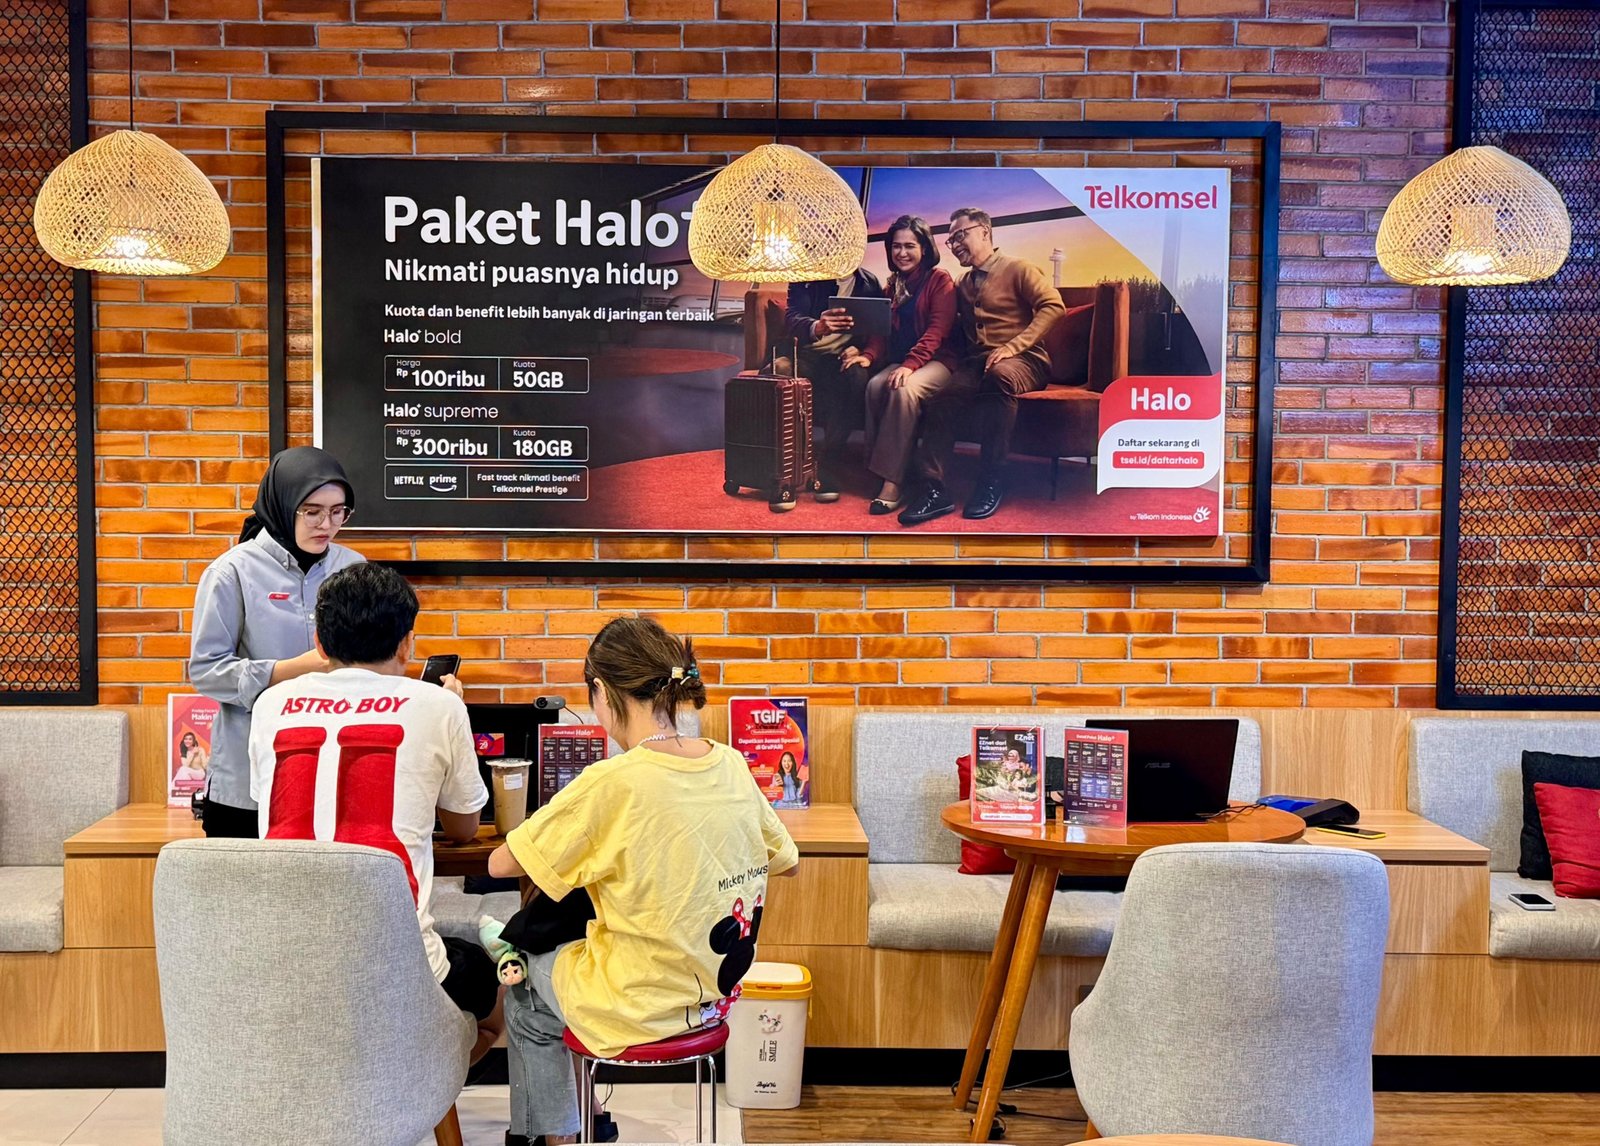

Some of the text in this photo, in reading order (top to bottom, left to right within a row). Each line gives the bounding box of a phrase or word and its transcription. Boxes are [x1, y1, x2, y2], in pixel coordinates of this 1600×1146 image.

[1084, 184, 1218, 210] Telkomsel
[384, 195, 541, 246] Paket
[384, 258, 679, 290] Nikmati puasnya hidup
[384, 304, 715, 323] Kuota dan benefit lebih banyak di jaringan terbaik
[424, 329, 462, 344] bold
[396, 359, 421, 368] Harga
[513, 360, 536, 368] Kuota
[396, 368, 485, 388] Rp 100ribu
[513, 371, 564, 388] 50GB
[1130, 387, 1192, 412] Halo
[424, 404, 499, 421] supreme
[396, 428, 421, 437] Harga
[513, 429, 536, 437] Kuota
[396, 437, 488, 456] Rp 300ribu
[513, 440, 573, 457] 180GB
[1118, 437, 1200, 449] Daftar sekarang di
[1119, 454, 1199, 466] tsel.id/daftarhalo
[394, 475, 424, 486] NETFLIX
[429, 474, 457, 485] prime
[477, 473, 581, 482] Fast track nikmati benefit
[492, 485, 568, 495] Telkomsel Prestige
[280, 696, 410, 716] ASTRO BOY
[750, 709, 786, 724] TGIF
[718, 873, 746, 892] Mickey
[768, 1040, 778, 1062] SMILE
